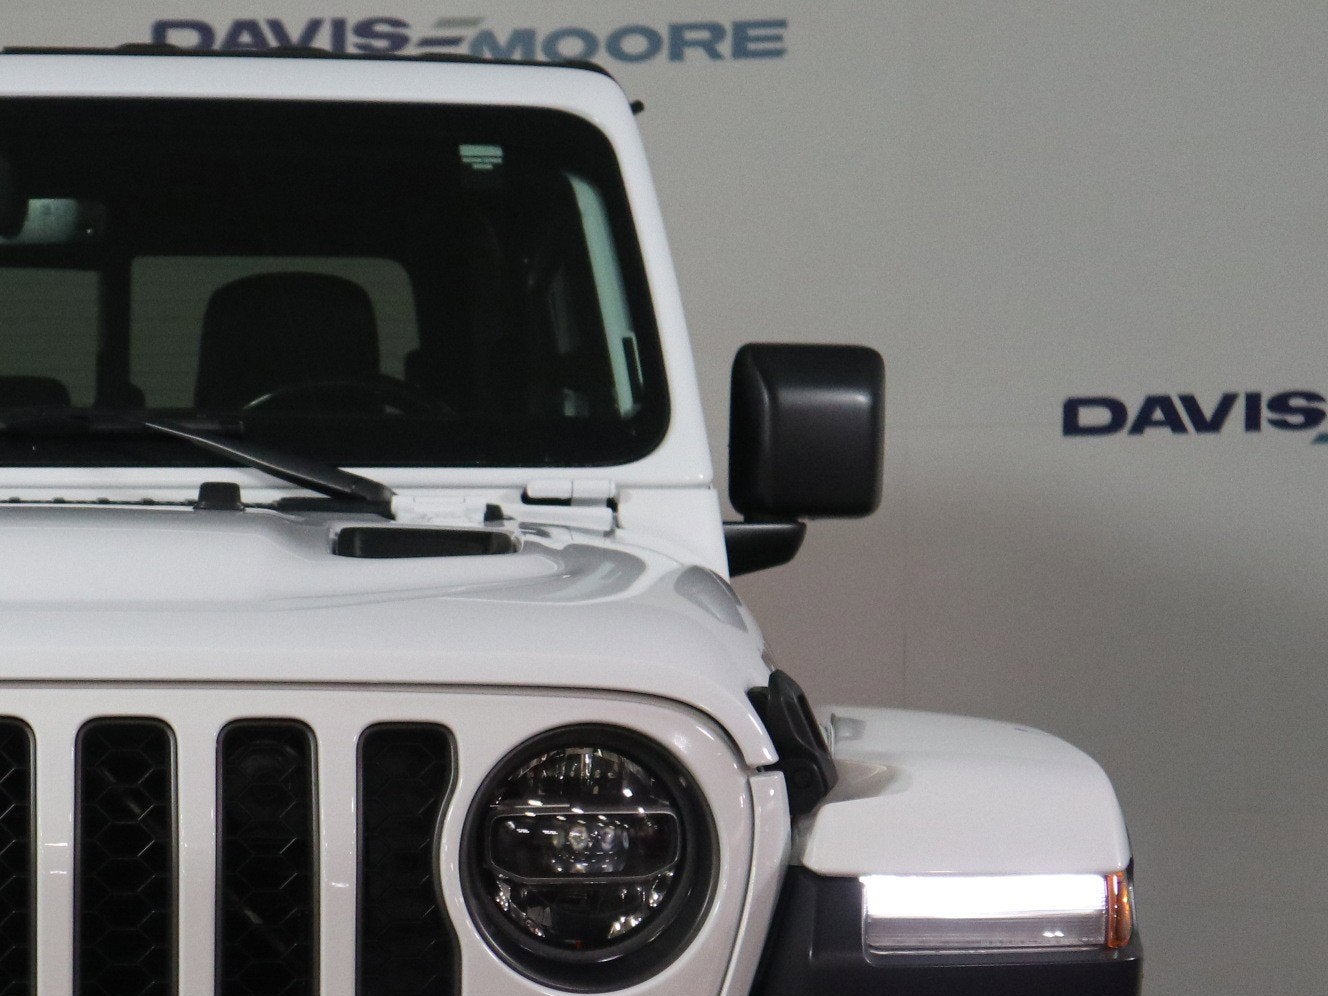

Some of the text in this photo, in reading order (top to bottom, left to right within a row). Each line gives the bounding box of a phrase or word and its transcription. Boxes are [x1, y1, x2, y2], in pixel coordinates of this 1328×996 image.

[151, 17, 787, 63] DAVIS MOORE
[1062, 390, 1327, 436] DAVIS
